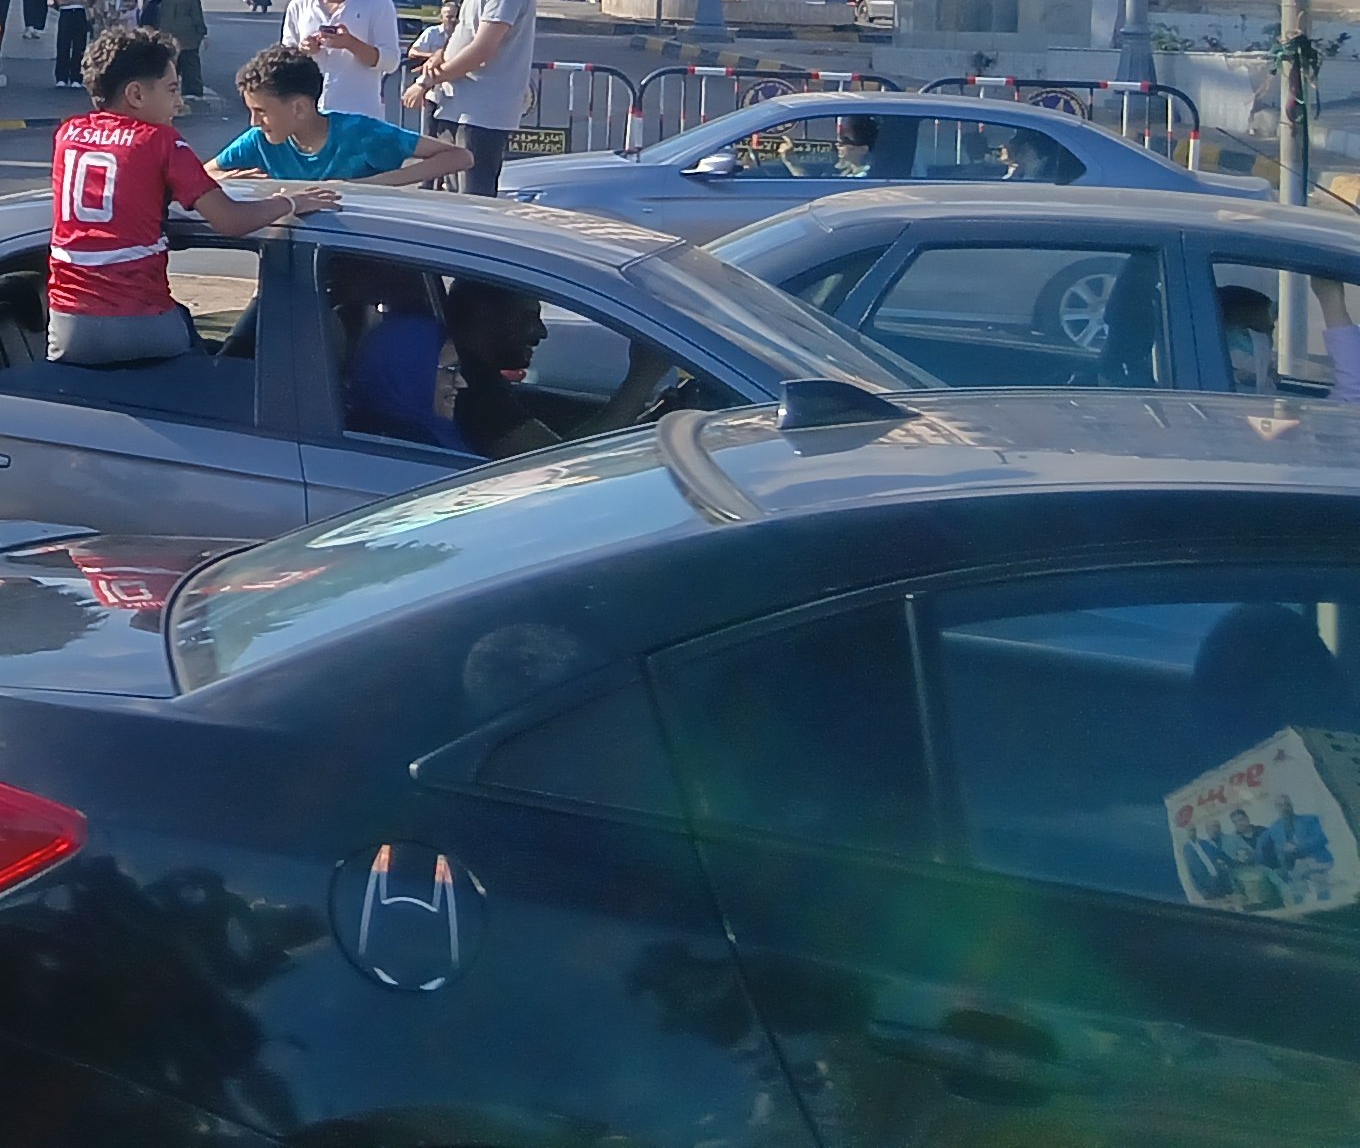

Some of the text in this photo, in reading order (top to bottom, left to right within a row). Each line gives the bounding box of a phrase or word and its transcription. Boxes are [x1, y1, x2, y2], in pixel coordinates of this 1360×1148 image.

[62, 124, 136, 147] M.SALAH
[521, 142, 562, 152] TRAFFIC
[61, 148, 118, 223] 10
